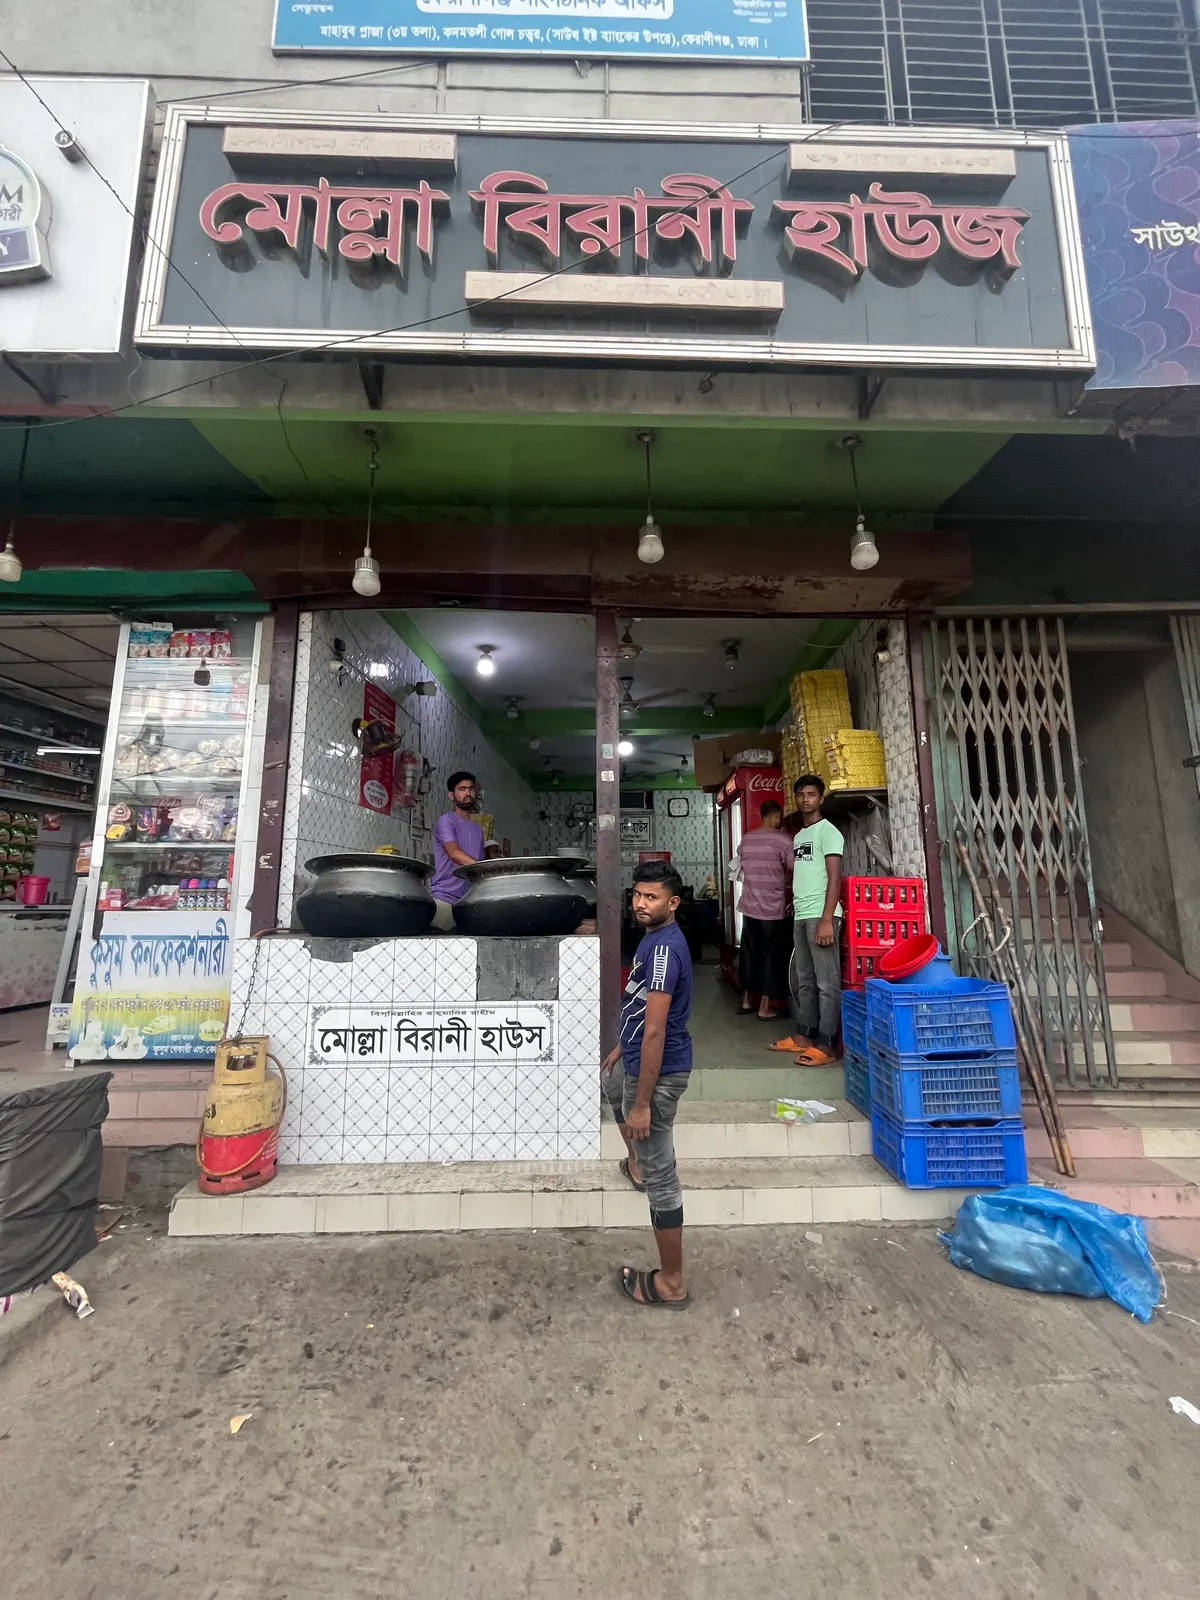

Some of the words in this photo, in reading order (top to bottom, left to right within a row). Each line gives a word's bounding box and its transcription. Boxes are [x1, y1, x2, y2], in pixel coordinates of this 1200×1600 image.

[360, 26, 384, 39] প্লাজা
[411, 25, 440, 41] তলা),
[442, 23, 487, 39] কদমতলী
[490, 27, 514, 41] গোল
[200, 177, 451, 266] মোল্লা
[468, 170, 754, 266] বিরানী
[772, 182, 1031, 276] হাউজ
[90, 935, 127, 991] কুসুম
[317, 1024, 388, 1056] মোল্লা
[394, 1017, 472, 1053] বিরানী
[478, 1017, 546, 1055] হাউস
